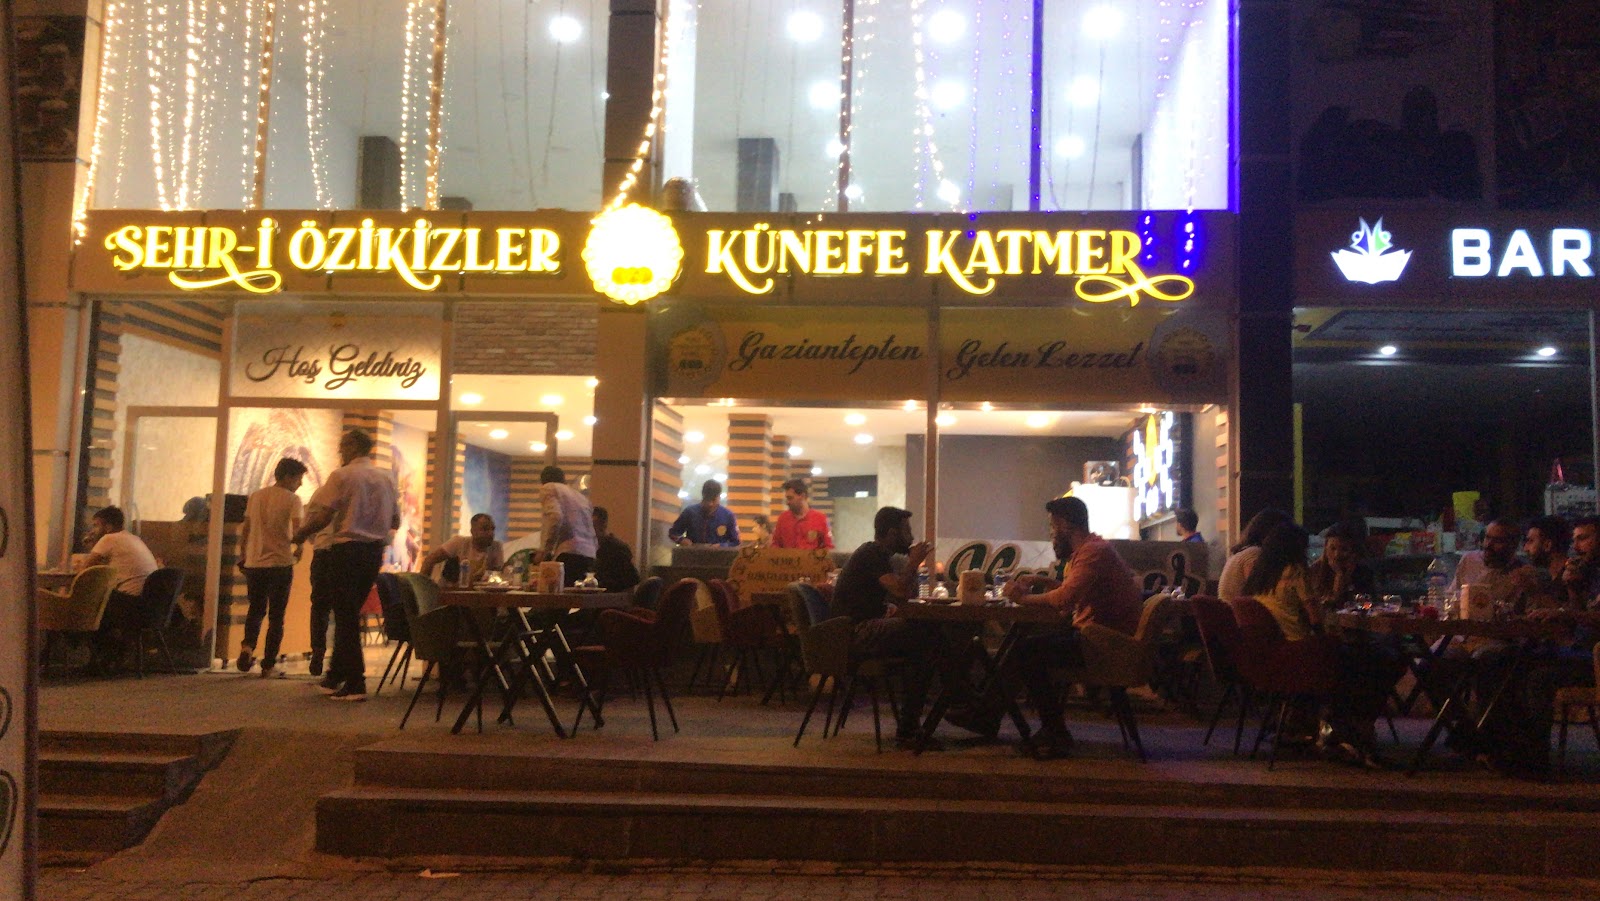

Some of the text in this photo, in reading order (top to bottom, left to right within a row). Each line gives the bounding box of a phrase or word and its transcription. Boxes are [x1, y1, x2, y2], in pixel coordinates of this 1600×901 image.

[288, 218, 560, 291] ÖZİKİZLER
[705, 222, 1194, 307] KÜNEFE KATMER
[1452, 228, 1596, 277] BAR
[246, 344, 426, 391] Hoş Geldiniz
[728, 330, 922, 375] Gaziantepten
[946, 338, 1032, 381] Gelen
[1034, 340, 1144, 369] Lezzet
